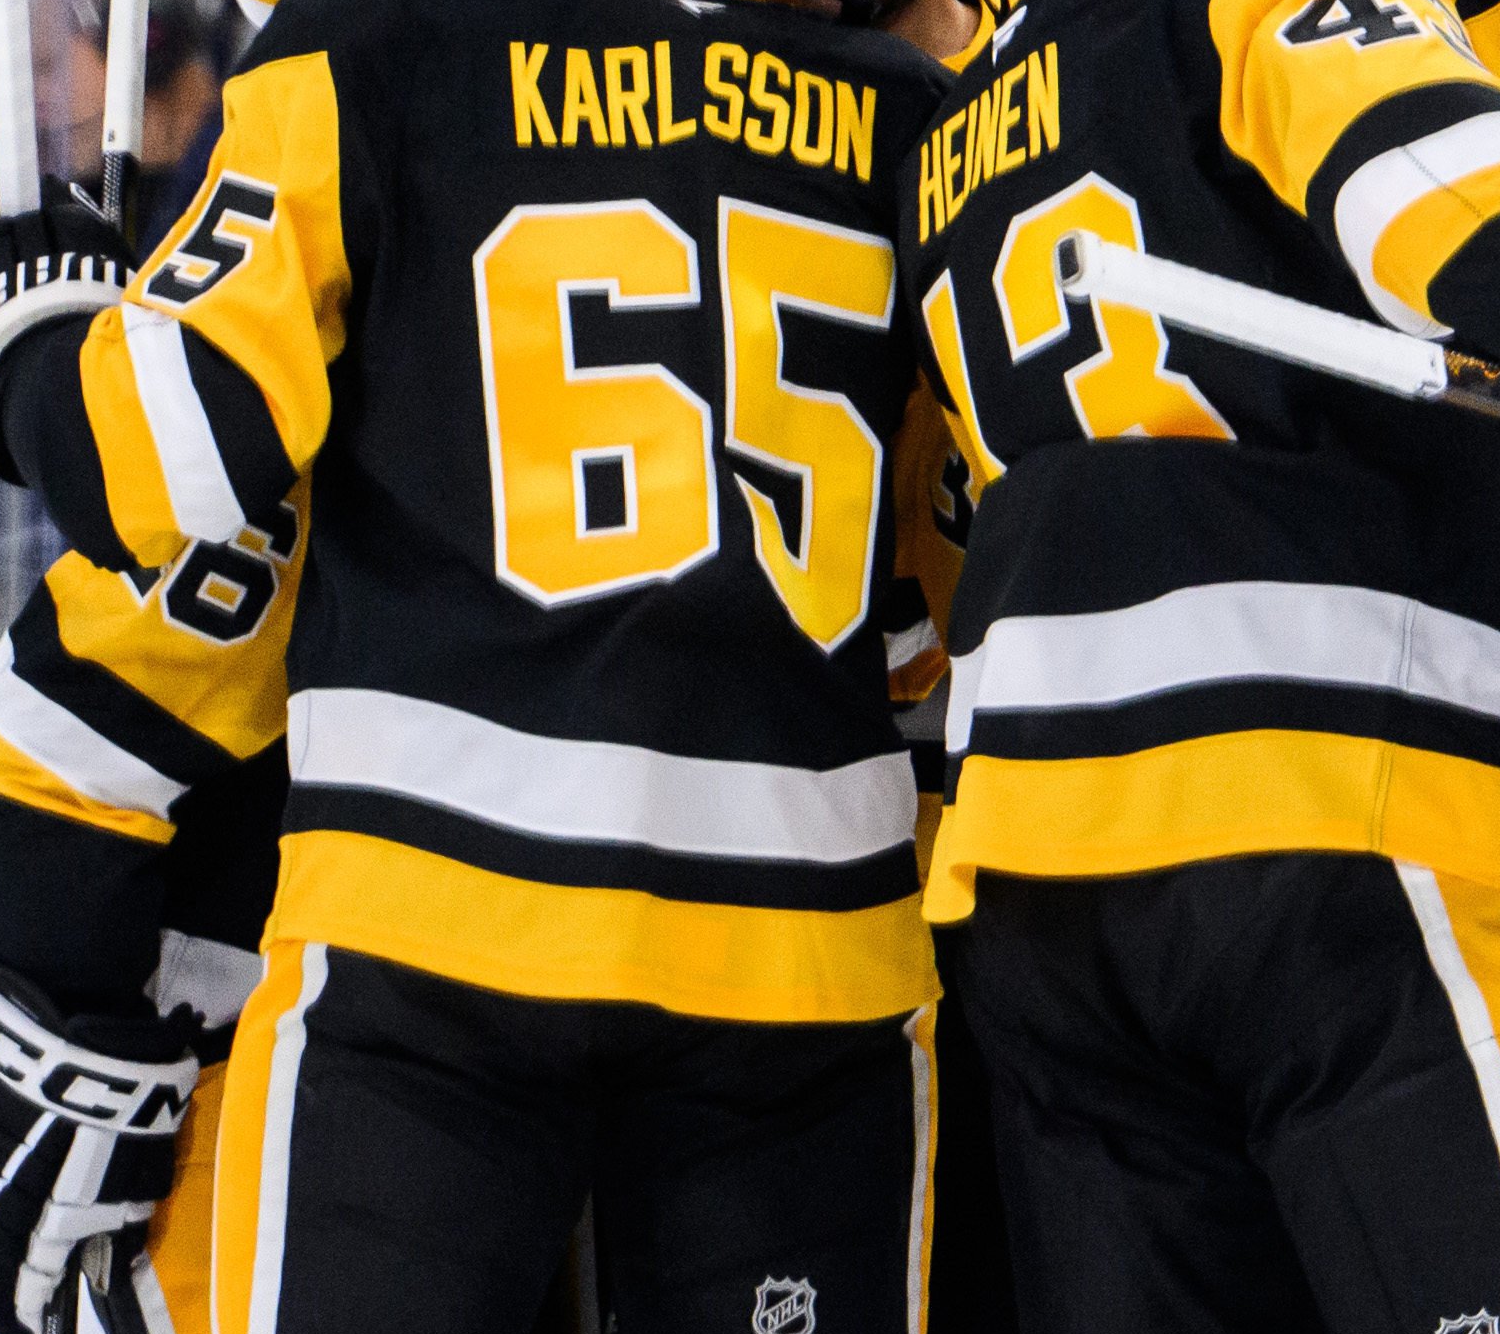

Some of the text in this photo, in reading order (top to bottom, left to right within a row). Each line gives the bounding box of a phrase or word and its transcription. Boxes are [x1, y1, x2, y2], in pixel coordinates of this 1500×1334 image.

[509, 40, 877, 185] KARLSSON
[919, 41, 1061, 245] HEINEN
[141, 169, 279, 309] 5
[472, 196, 897, 656] 65
[767, 1296, 804, 1331] NHL
